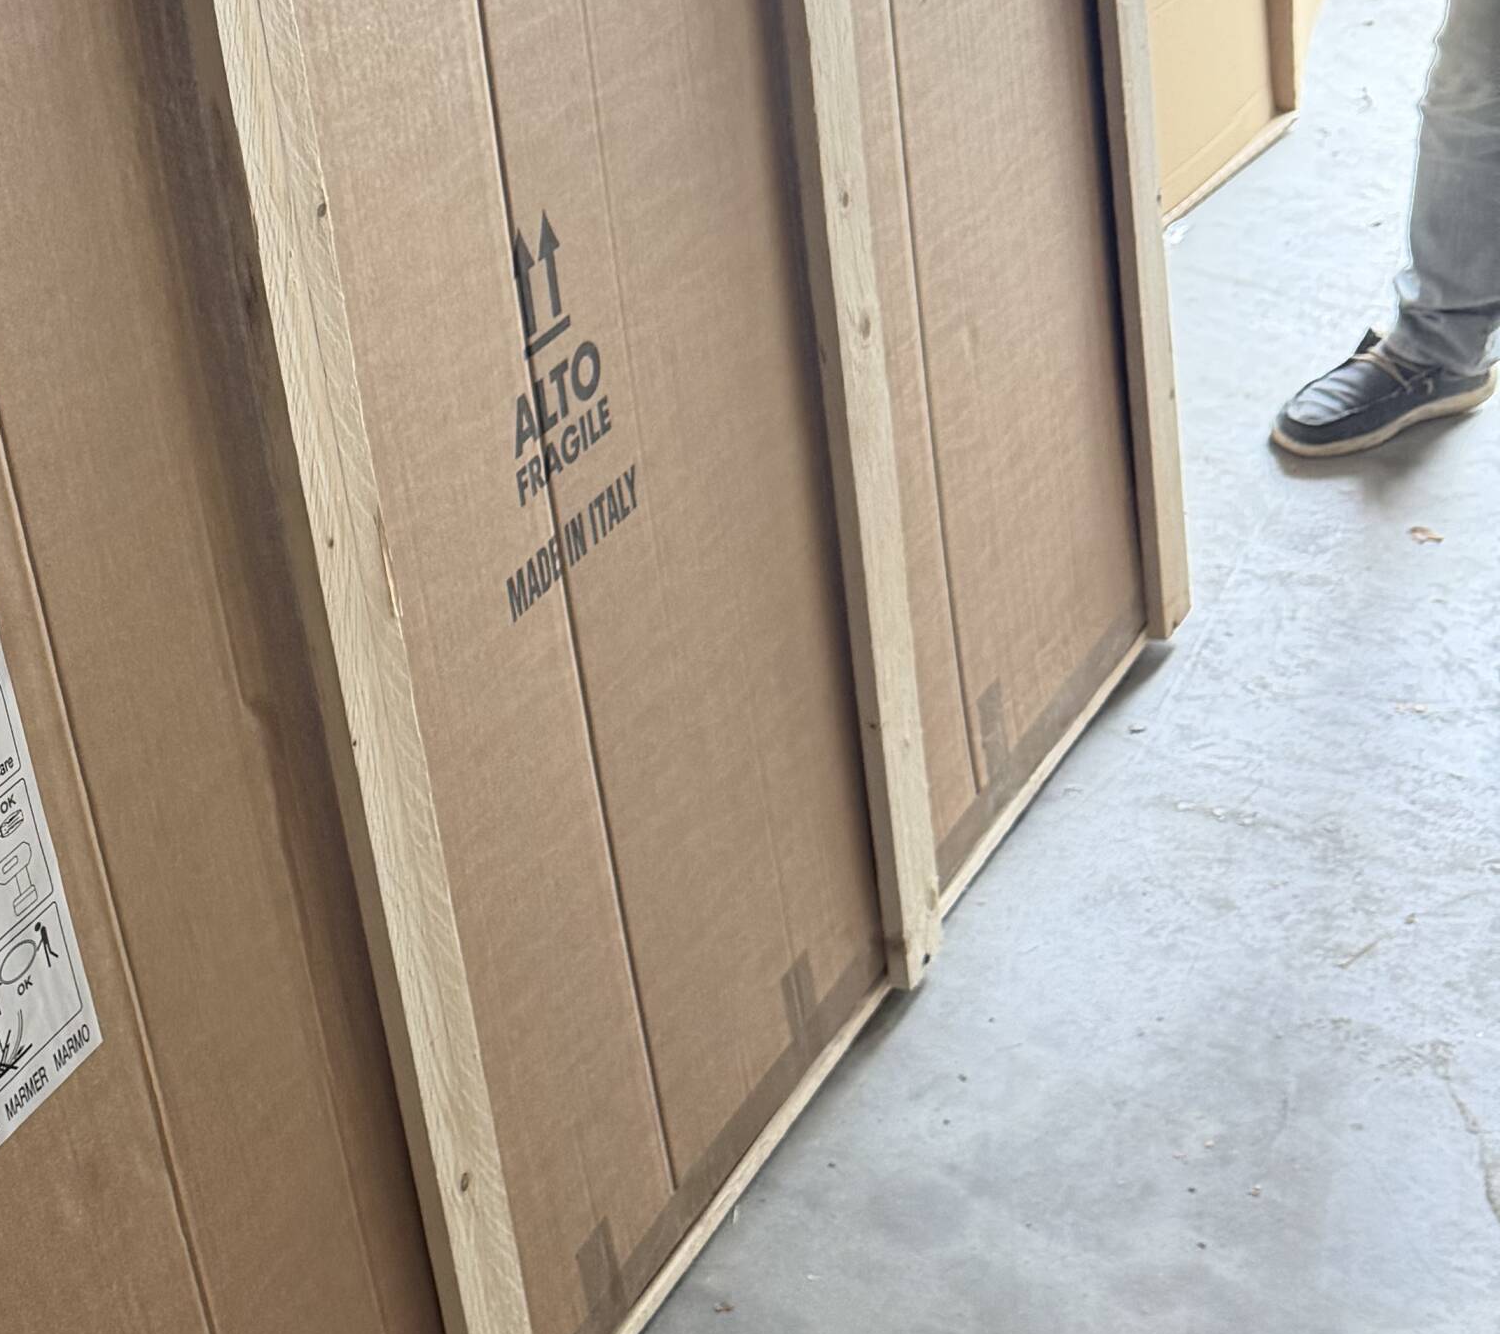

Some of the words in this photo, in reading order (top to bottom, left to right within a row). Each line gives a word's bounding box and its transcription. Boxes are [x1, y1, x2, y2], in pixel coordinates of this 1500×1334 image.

[513, 340, 602, 460] ALTO
[515, 395, 612, 507] FRAGILE
[506, 535, 562, 623] MADE
[563, 511, 586, 566] IN
[589, 465, 638, 545] ITALY
[0, 794, 17, 814] OK
[17, 976, 33, 996] OK
[4, 1066, 49, 1121] MARMER
[53, 1023, 91, 1072] MARMO
